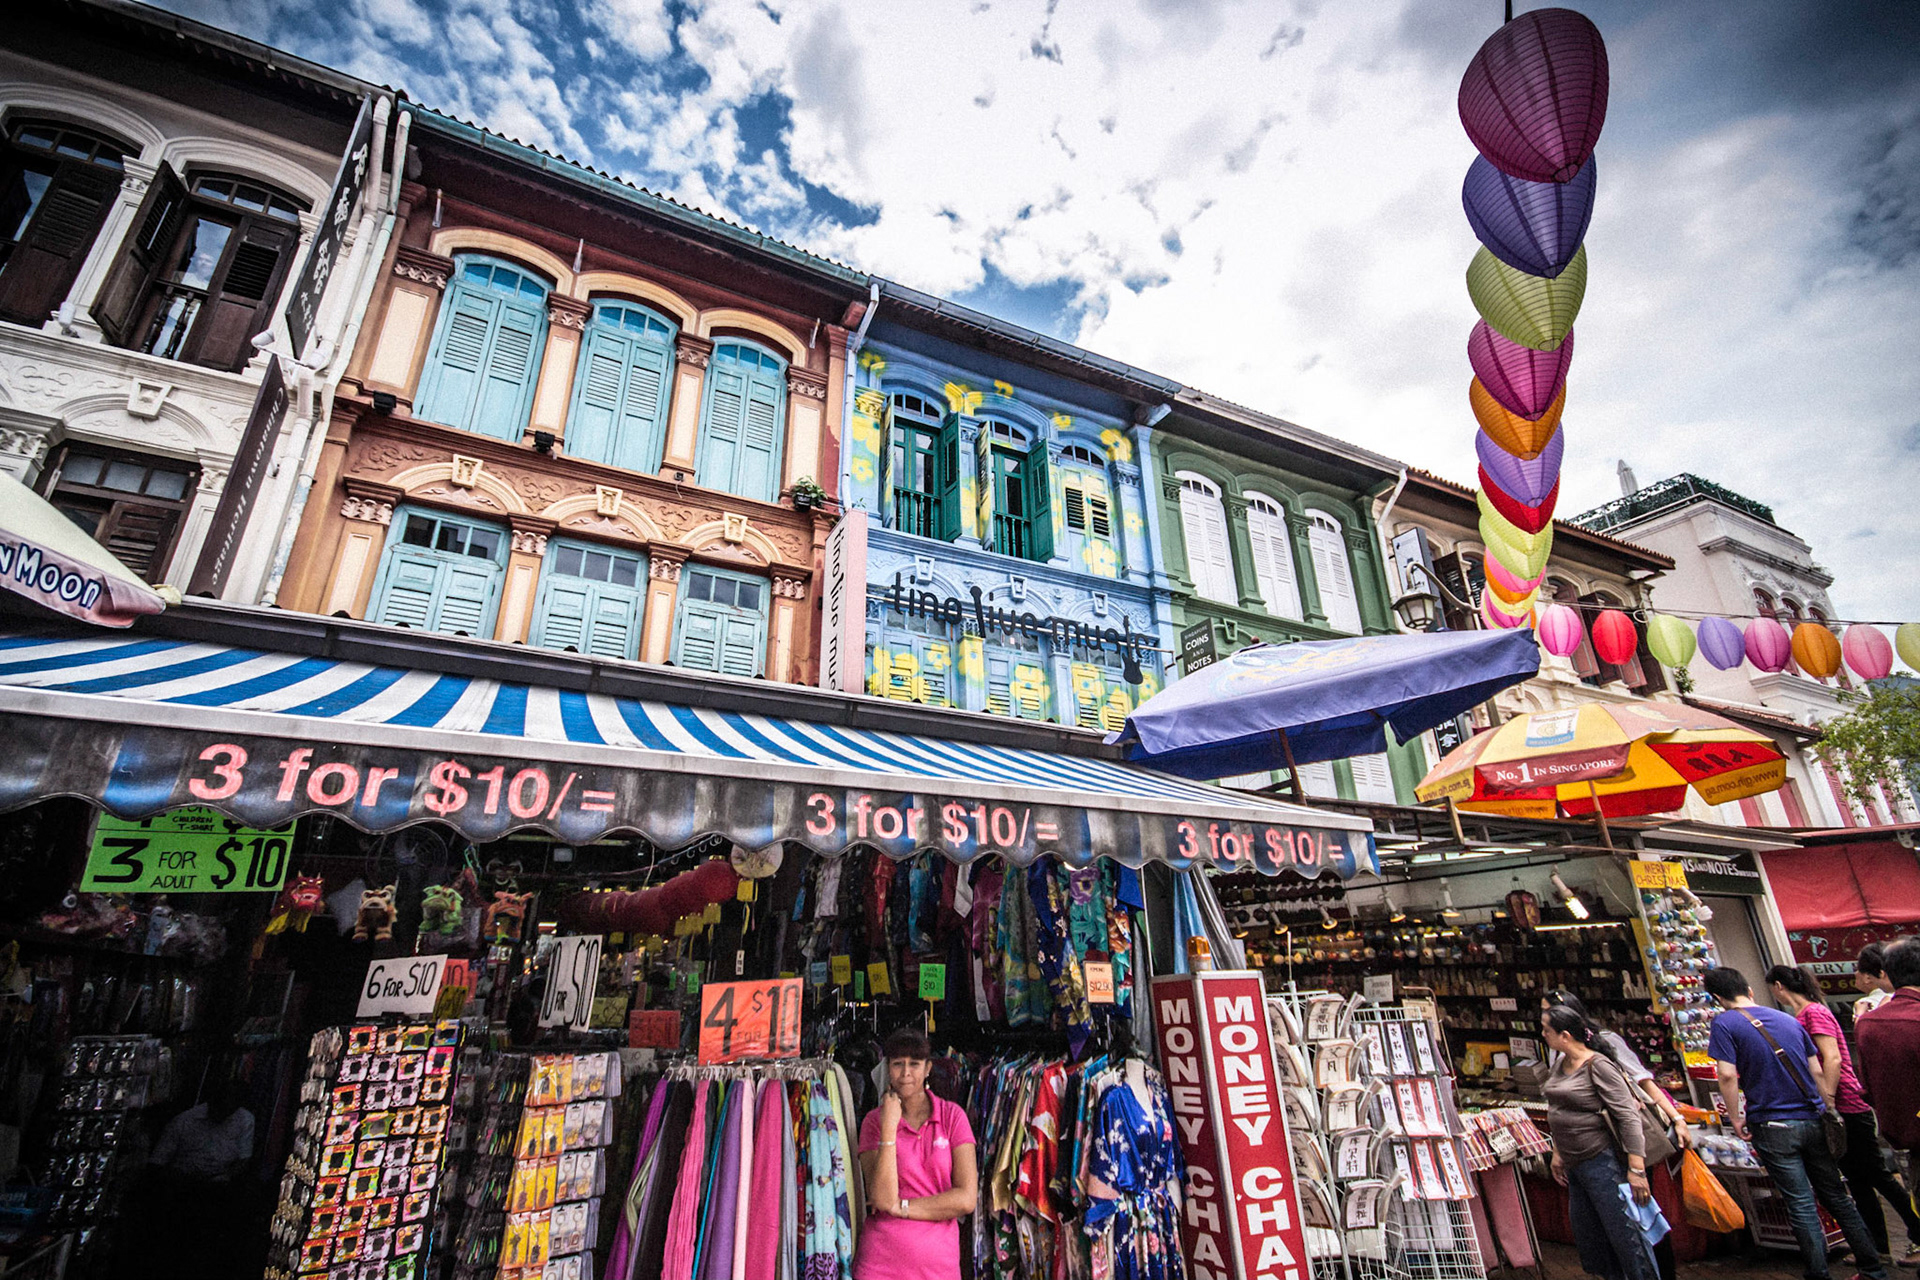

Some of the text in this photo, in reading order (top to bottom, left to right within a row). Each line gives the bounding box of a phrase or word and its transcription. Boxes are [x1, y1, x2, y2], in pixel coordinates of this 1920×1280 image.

[211, 387, 284, 585] Chinatown Heritage
[891, 571, 1150, 684] tino live music
[1185, 633, 1209, 651] COINS
[1187, 655, 1212, 672] NOTES
[1192, 648, 1205, 657] AND
[189, 743, 248, 799] 3
[275, 748, 398, 807] for
[1496, 770, 1518, 782] No.
[1517, 762, 1534, 783] 1
[806, 793, 836, 836] 3
[854, 795, 924, 839] for
[1177, 821, 1199, 858] 3
[1207, 823, 1254, 860] for
[93, 837, 287, 889] 3 FOR $10
[151, 875, 197, 889] ADULT
[1636, 875, 1686, 886] CHRISTMAS
[1644, 863, 1670, 874] MERRY
[1707, 860, 1739, 876] NOTES
[367, 961, 437, 998] 6 FOR $10
[564, 938, 599, 1026] $10
[704, 987, 738, 1056] 4
[752, 985, 800, 1054] $10
[1161, 998, 1204, 1146] MONEY
[1213, 995, 1271, 1147] MONEY
